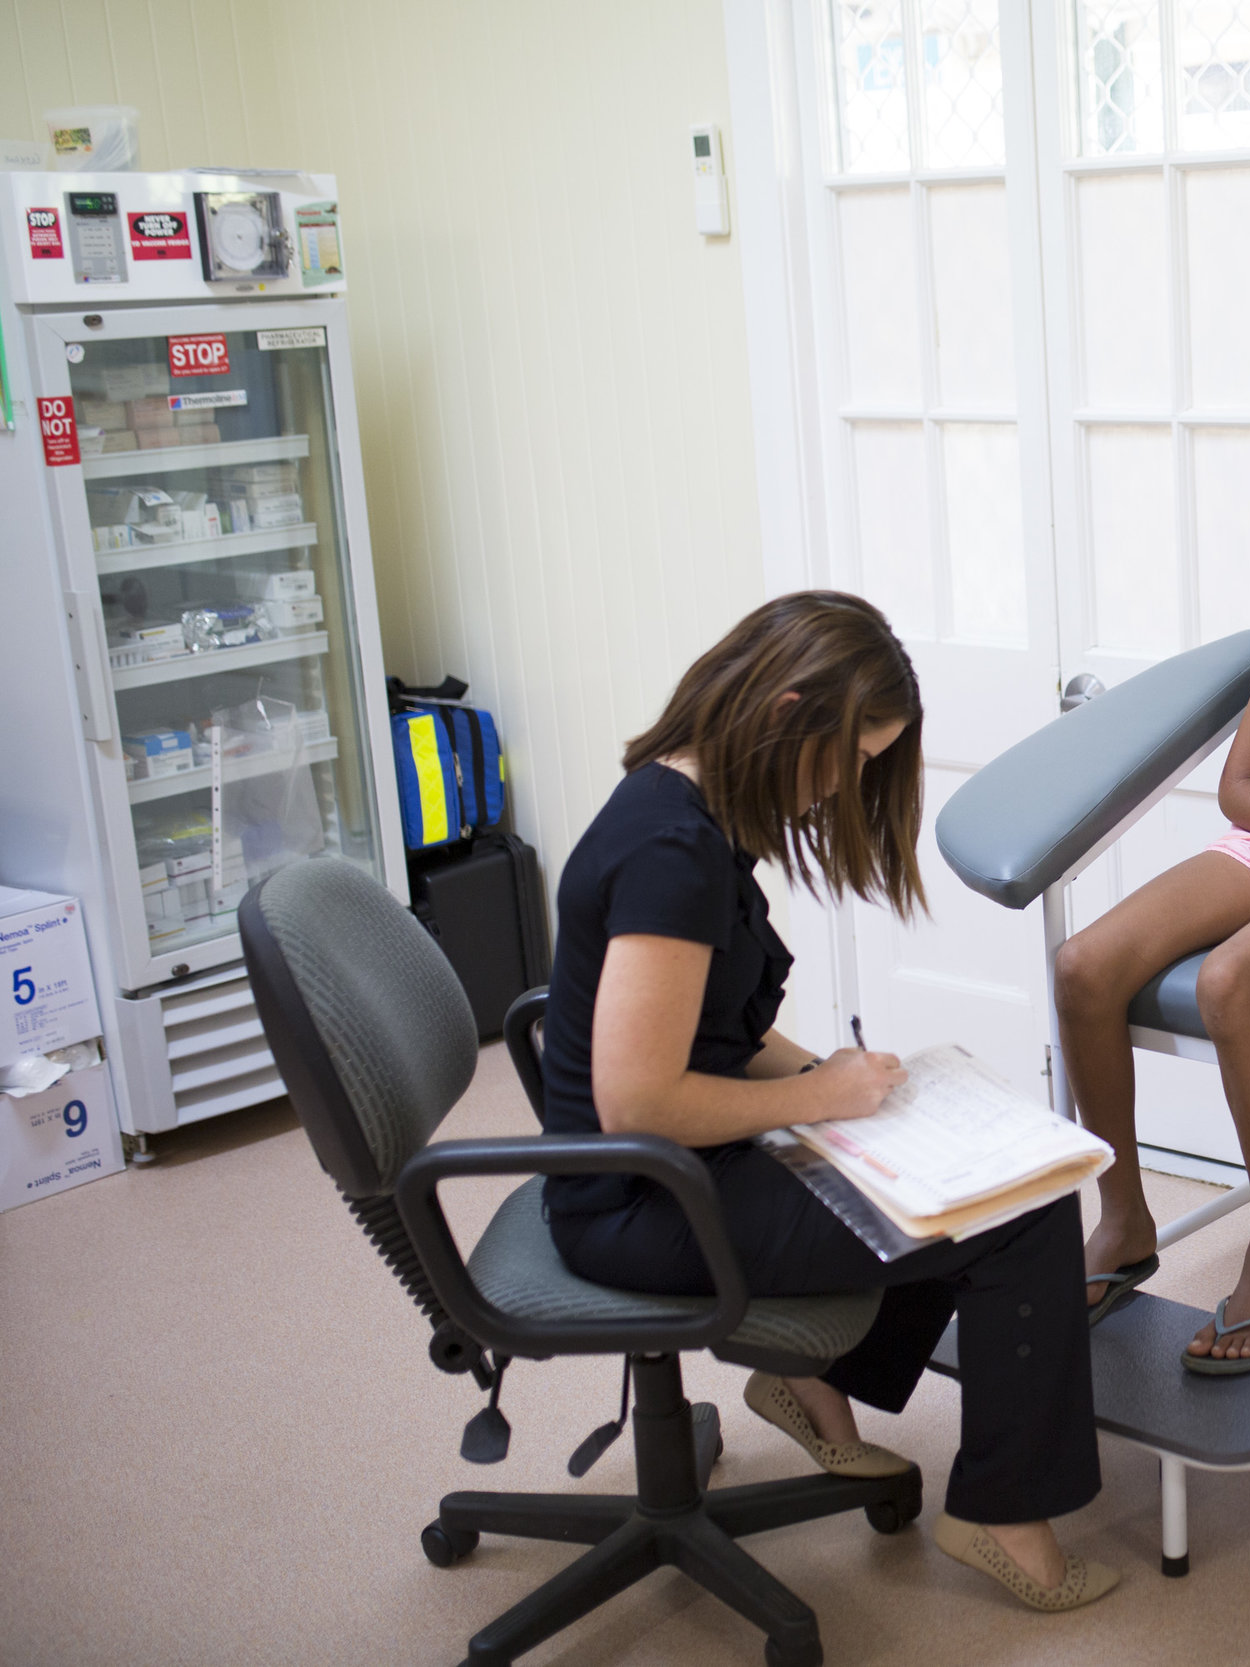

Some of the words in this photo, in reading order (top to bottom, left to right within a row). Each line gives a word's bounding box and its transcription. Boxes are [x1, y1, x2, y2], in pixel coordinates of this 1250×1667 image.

[29, 212, 56, 227] STOP
[138, 222, 161, 230] TURN
[162, 221, 178, 229] OFF
[144, 229, 175, 237] POWER
[172, 342, 225, 366] STOP
[183, 394, 232, 406] Thermoline
[42, 399, 66, 417] DO
[42, 418, 72, 436] NOT
[34, 917, 61, 933] Splint
[13, 965, 35, 1005] 5
[34, 1172, 62, 1187] Splint
